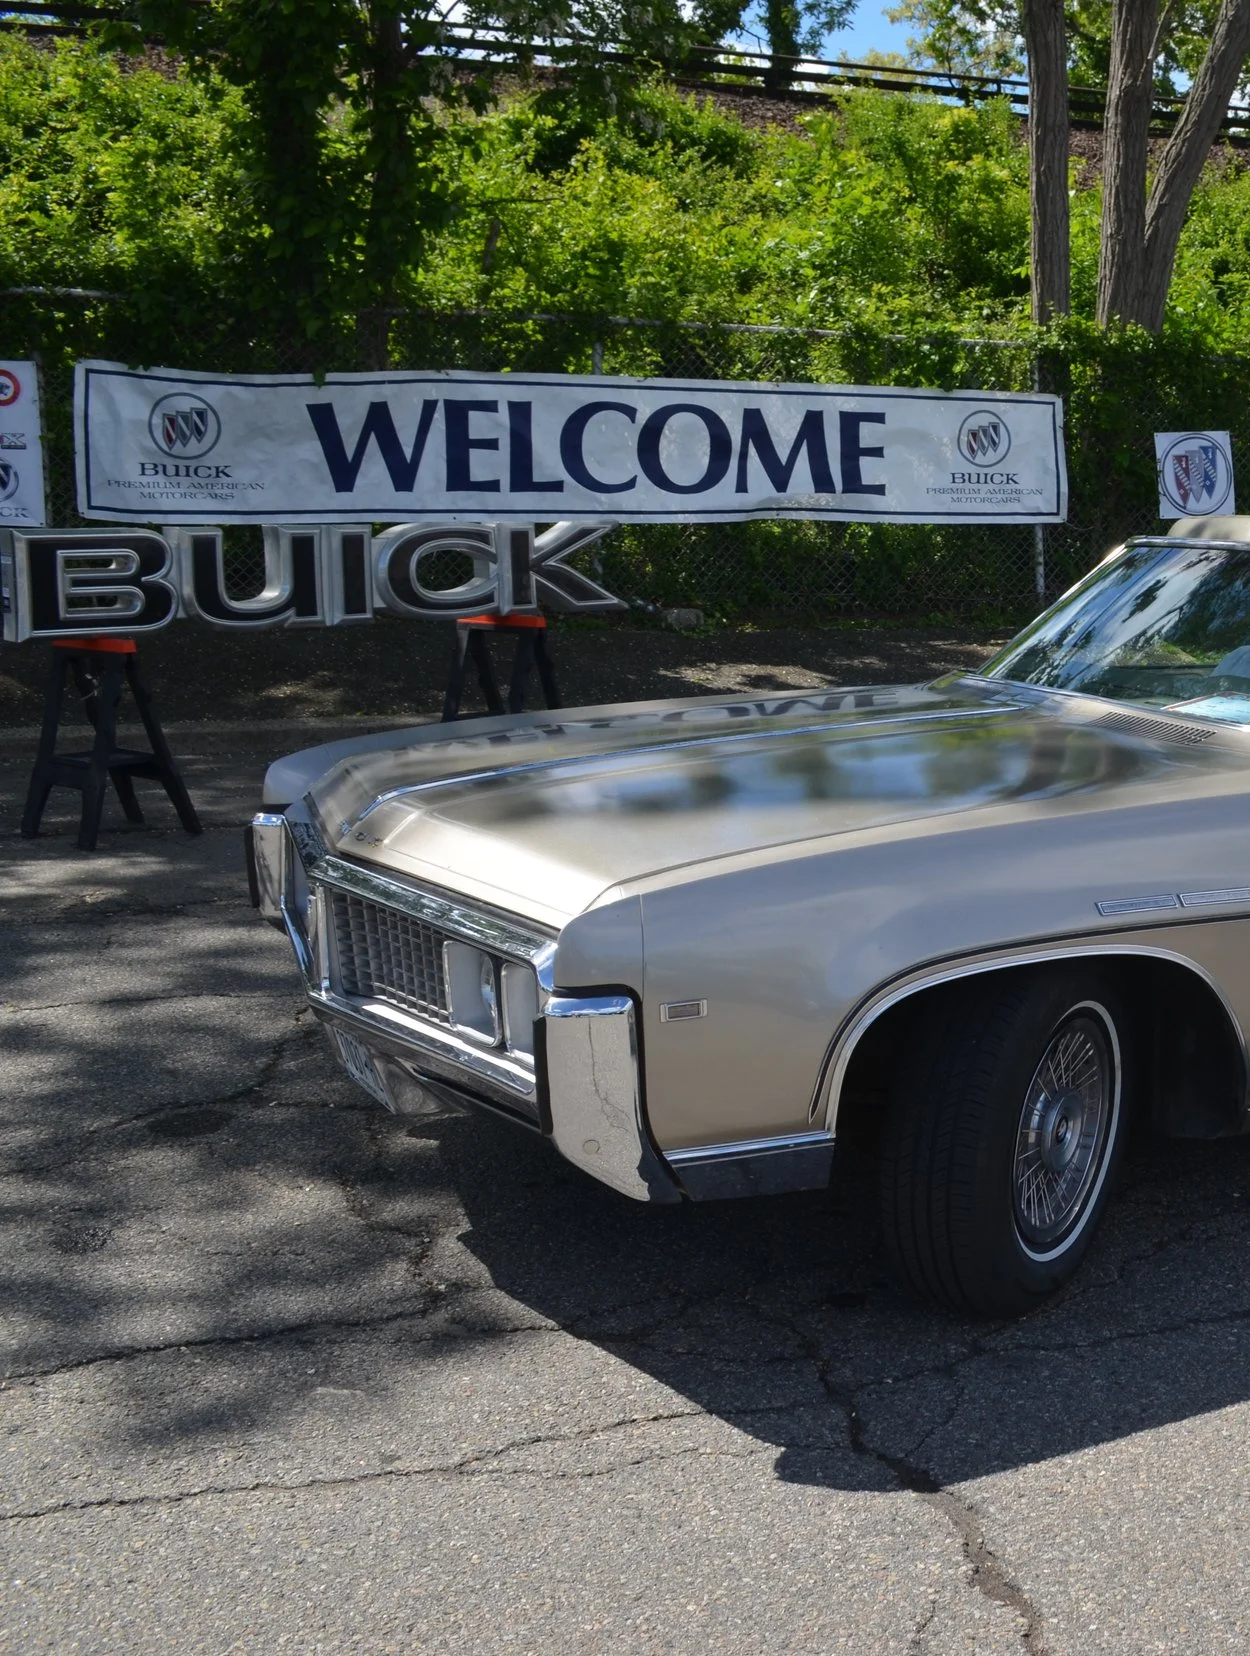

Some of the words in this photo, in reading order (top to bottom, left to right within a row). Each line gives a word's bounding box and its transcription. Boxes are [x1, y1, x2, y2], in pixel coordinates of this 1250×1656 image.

[305, 398, 887, 497] WELCOME
[138, 462, 233, 479] BUICK
[107, 479, 181, 489] PREMIUM
[186, 481, 265, 490] AMERICAN
[950, 472, 1020, 485] BUICK
[139, 491, 235, 500] MOTORCARS
[926, 487, 981, 495] PREMIUM
[984, 488, 1044, 496] AMERICAN
[950, 496, 1021, 504] MOTORCARS
[3, 520, 629, 643] BUICK
